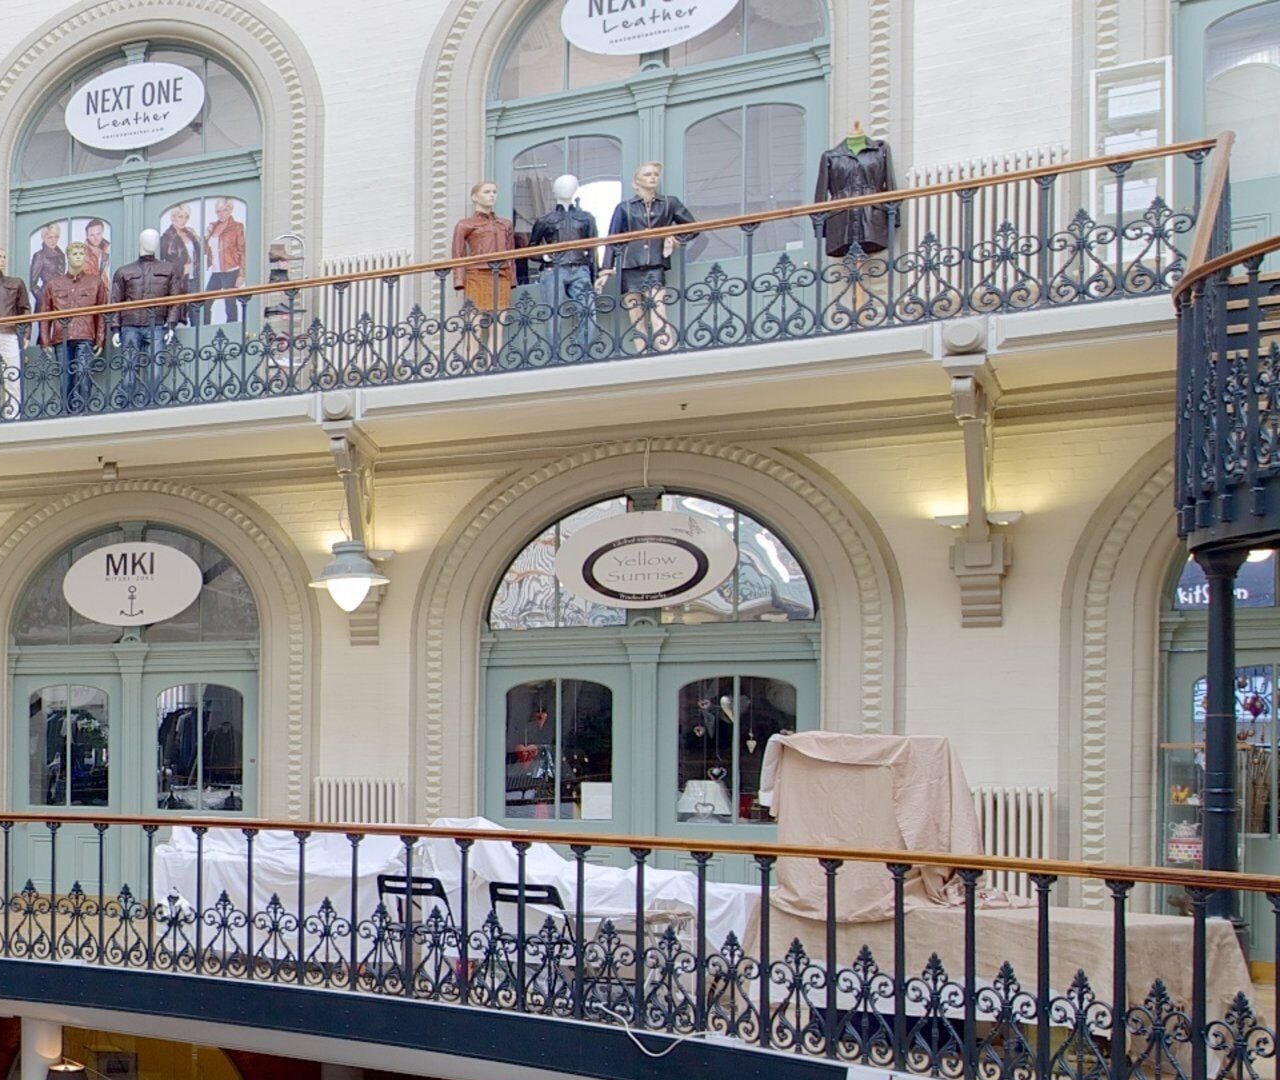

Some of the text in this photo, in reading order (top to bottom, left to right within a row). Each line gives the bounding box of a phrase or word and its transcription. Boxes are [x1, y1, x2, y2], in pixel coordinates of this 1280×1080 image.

[603, 6, 697, 34] Leather
[86, 77, 183, 115] NEXT ONE
[97, 111, 170, 131] Leather
[106, 552, 155, 576] MKI
[613, 551, 677, 567] Yellow
[606, 570, 685, 583] Sunrise
